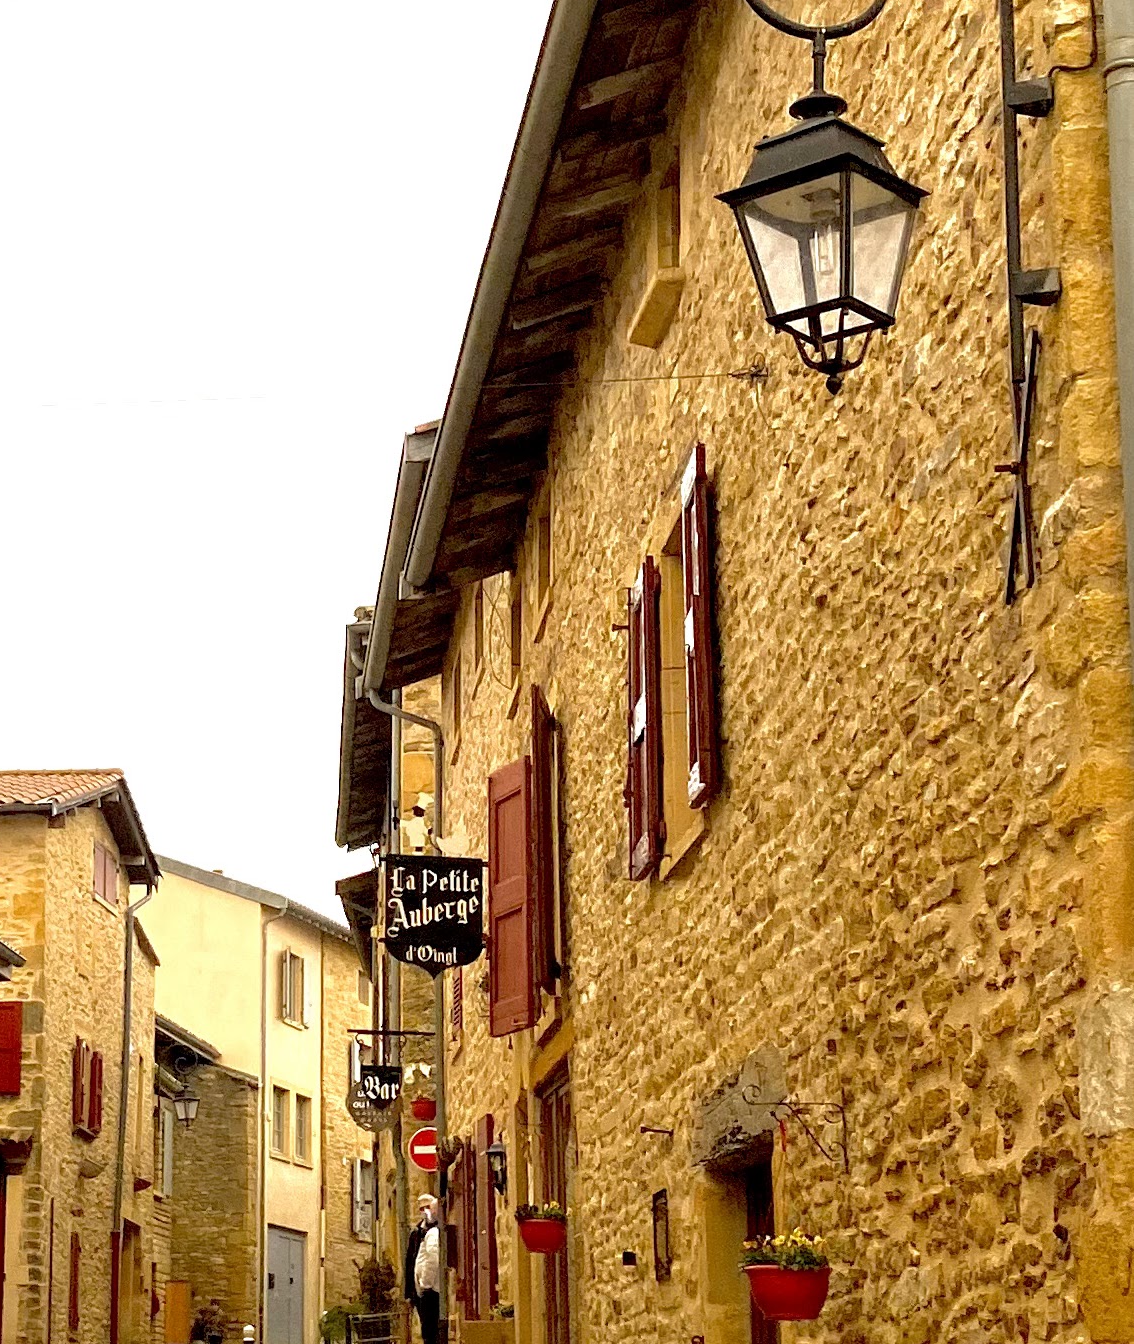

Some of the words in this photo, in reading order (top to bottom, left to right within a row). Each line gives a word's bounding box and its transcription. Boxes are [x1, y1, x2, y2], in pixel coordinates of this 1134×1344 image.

[390, 866, 416, 897] La
[422, 869, 479, 894] Petite
[387, 895, 479, 938] Auberge
[364, 1075, 400, 1100] Bar
